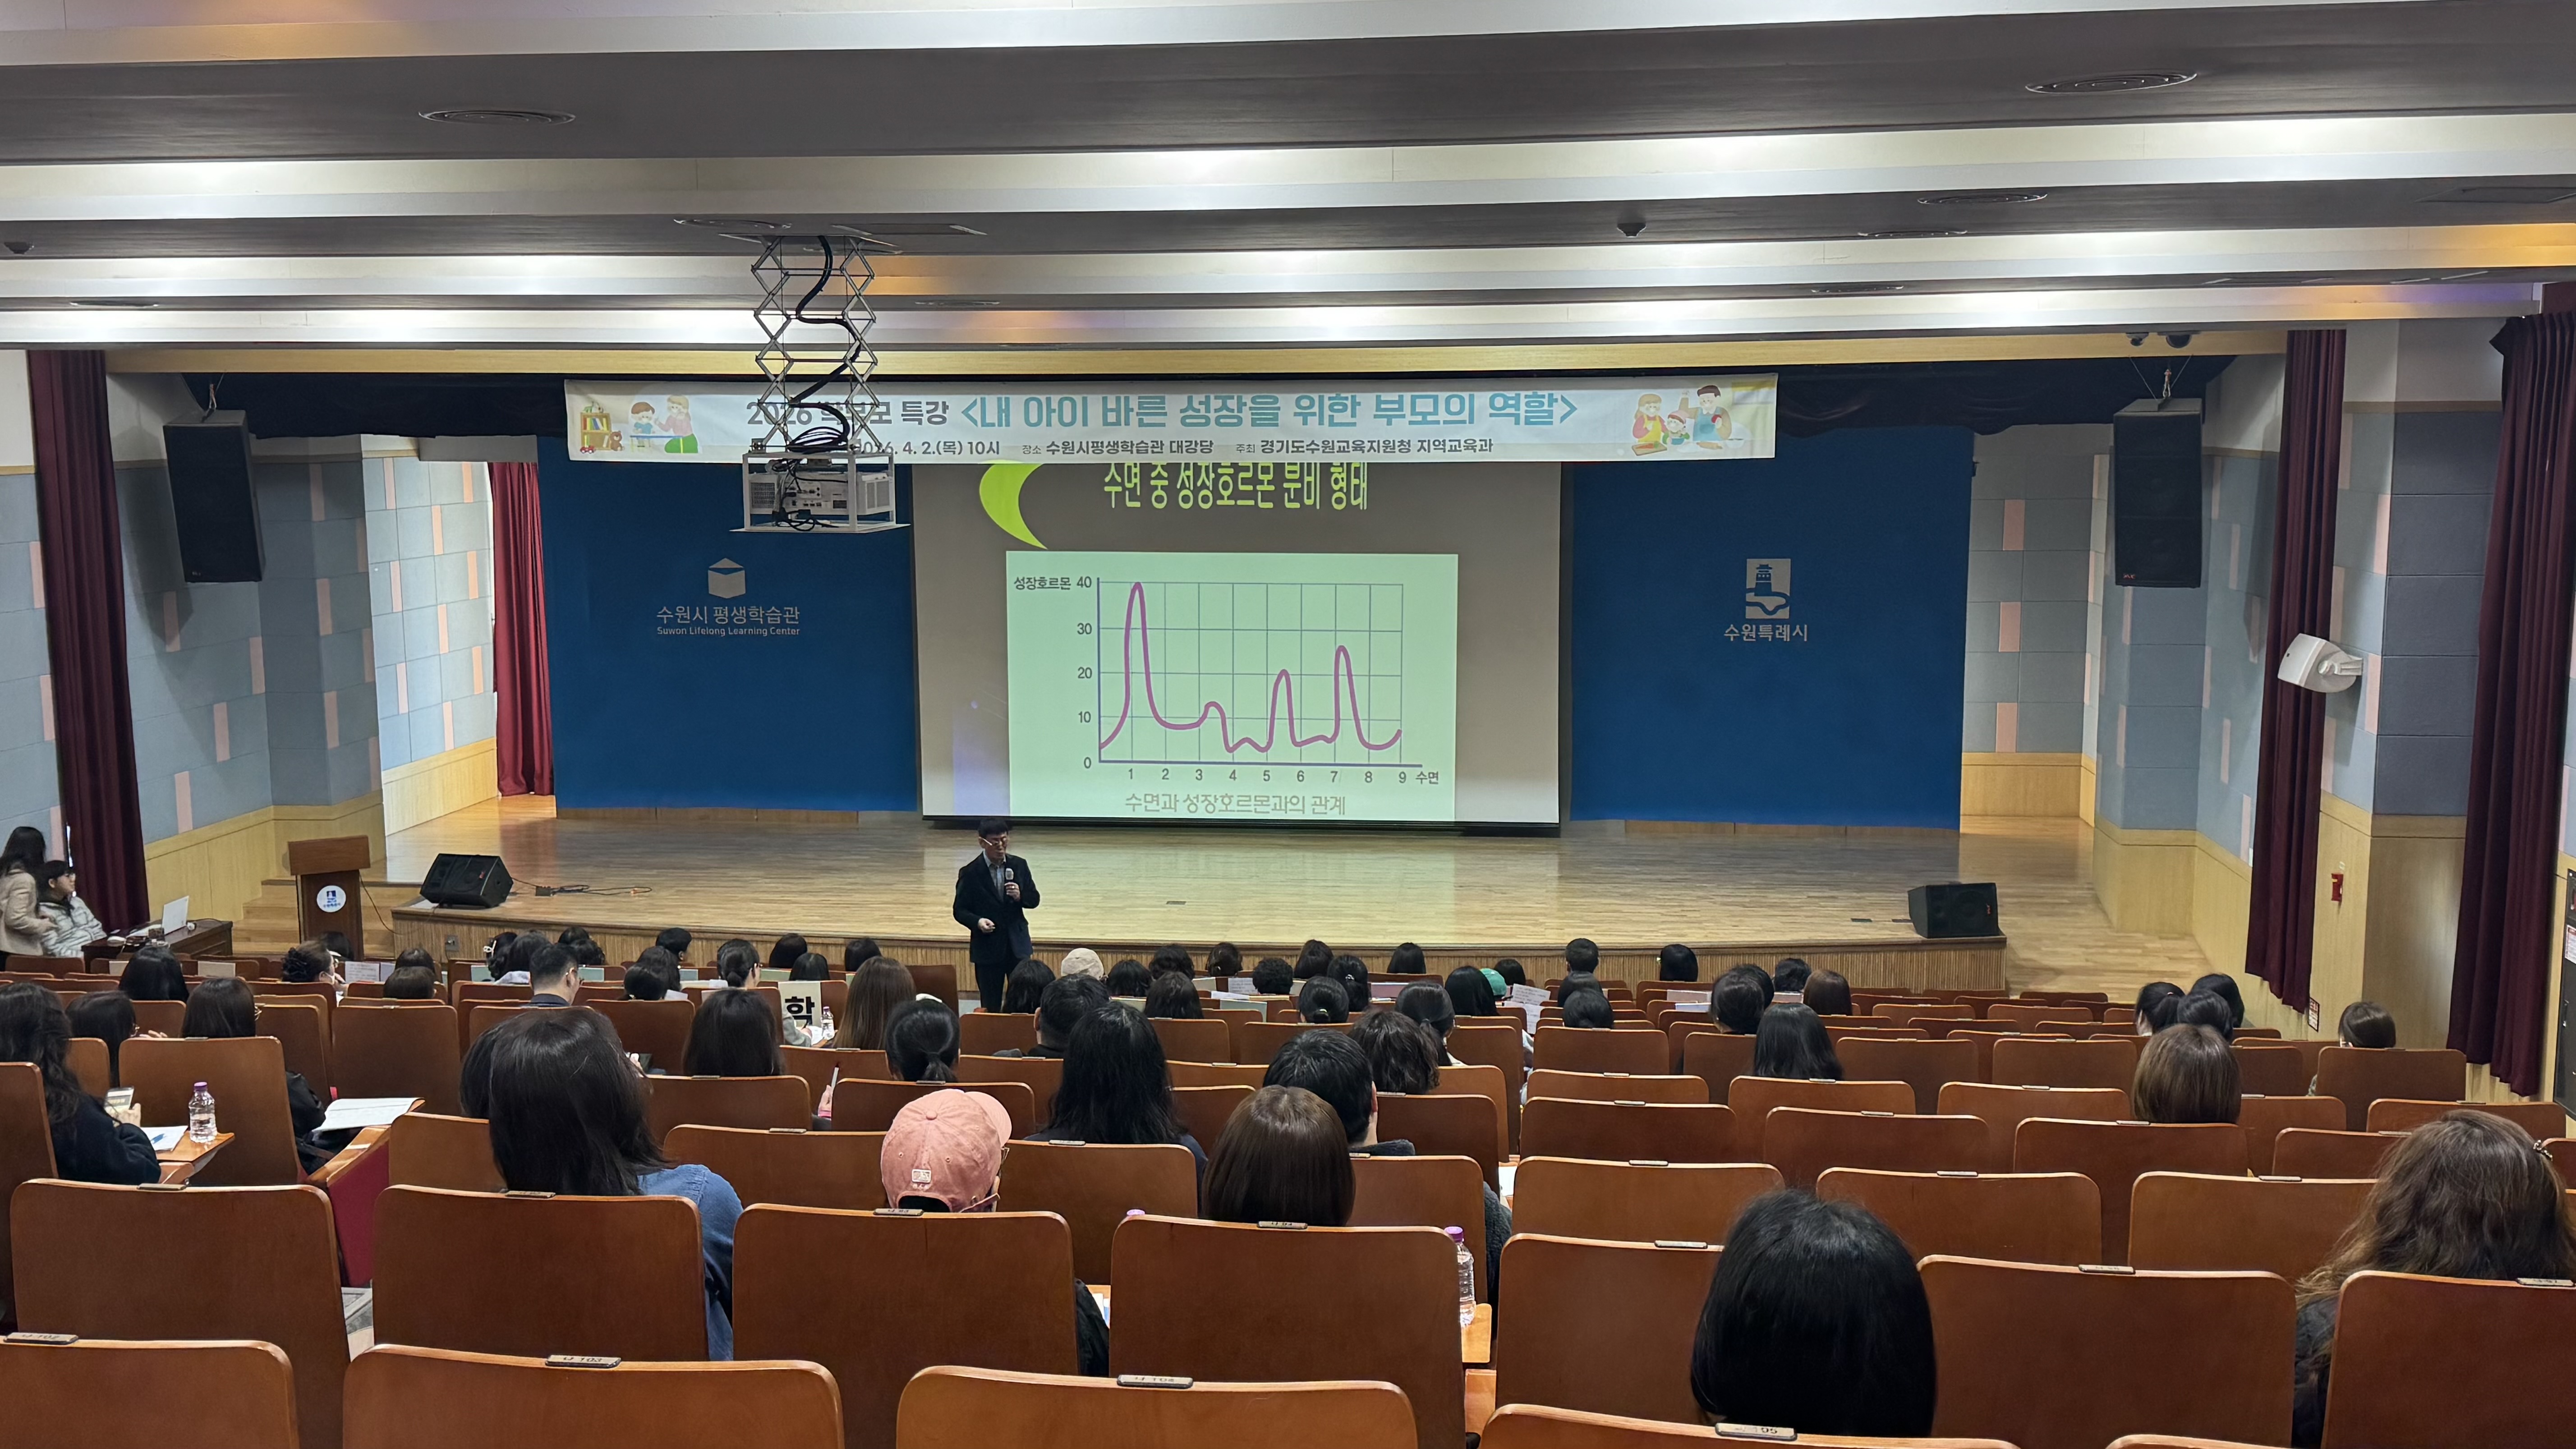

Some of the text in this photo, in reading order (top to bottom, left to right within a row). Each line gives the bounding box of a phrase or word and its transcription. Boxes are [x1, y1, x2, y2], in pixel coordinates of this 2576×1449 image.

[901, 400, 949, 426] 특강
[1023, 396, 1088, 428] 아이
[1102, 395, 1168, 428] 바른
[1180, 394, 1281, 427] 성장을
[1293, 393, 1362, 427] 위한
[1373, 393, 1475, 426] 부모의
[1489, 391, 1578, 426] 역할>
[967, 441, 999, 455] 10시
[1022, 445, 1041, 455] 장소
[1046, 440, 1165, 455] 수원시평생학습관
[1169, 439, 1214, 455] 대강당
[1236, 443, 1256, 454] 주최
[1260, 439, 1411, 454] 경기도수원교육지원청
[1417, 438, 1494, 453] 지역교육과
[1104, 462, 1367, 511] 수면 중 성장호르몬 분비 형태
[1014, 576, 1092, 590] 성장호르몬 40
[657, 606, 800, 624] 수원시 평생학습관
[657, 626, 800, 637] Suwon Lifelong Learning Center
[1076, 623, 1092, 635] 30
[1724, 624, 1808, 642] 수원특례시
[1077, 667, 1093, 679] 20
[1078, 711, 1091, 723] 10
[1083, 756, 1092, 769] 0
[1128, 768, 1439, 785] 1 2 3 4 5 6 7 8 9 수면
[1125, 793, 1346, 815] 수면과 성장호르몬과의 관계
